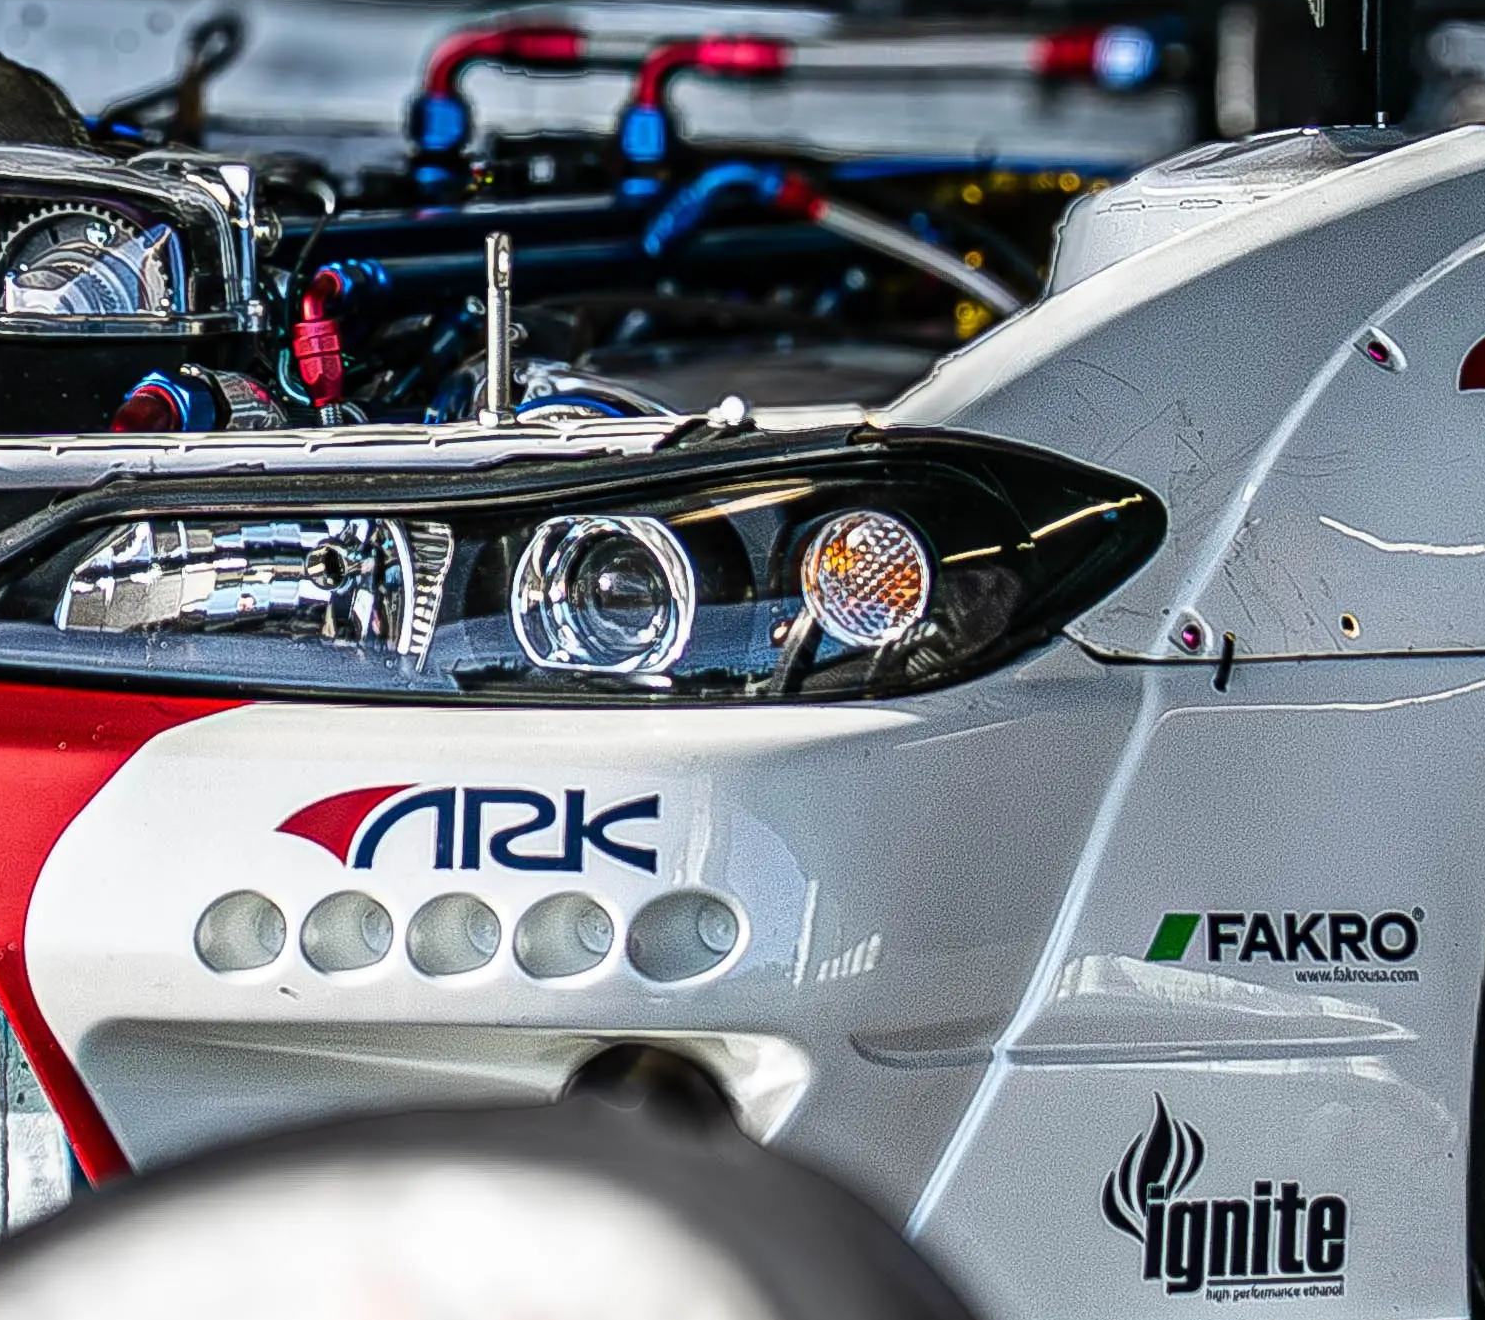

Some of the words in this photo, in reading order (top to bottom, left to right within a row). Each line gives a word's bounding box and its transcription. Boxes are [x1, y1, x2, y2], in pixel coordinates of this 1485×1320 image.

[275, 783, 660, 874] ARK
[1142, 1181, 1347, 1295] ignite
[1303, 1281, 1345, 1298] ethanol
